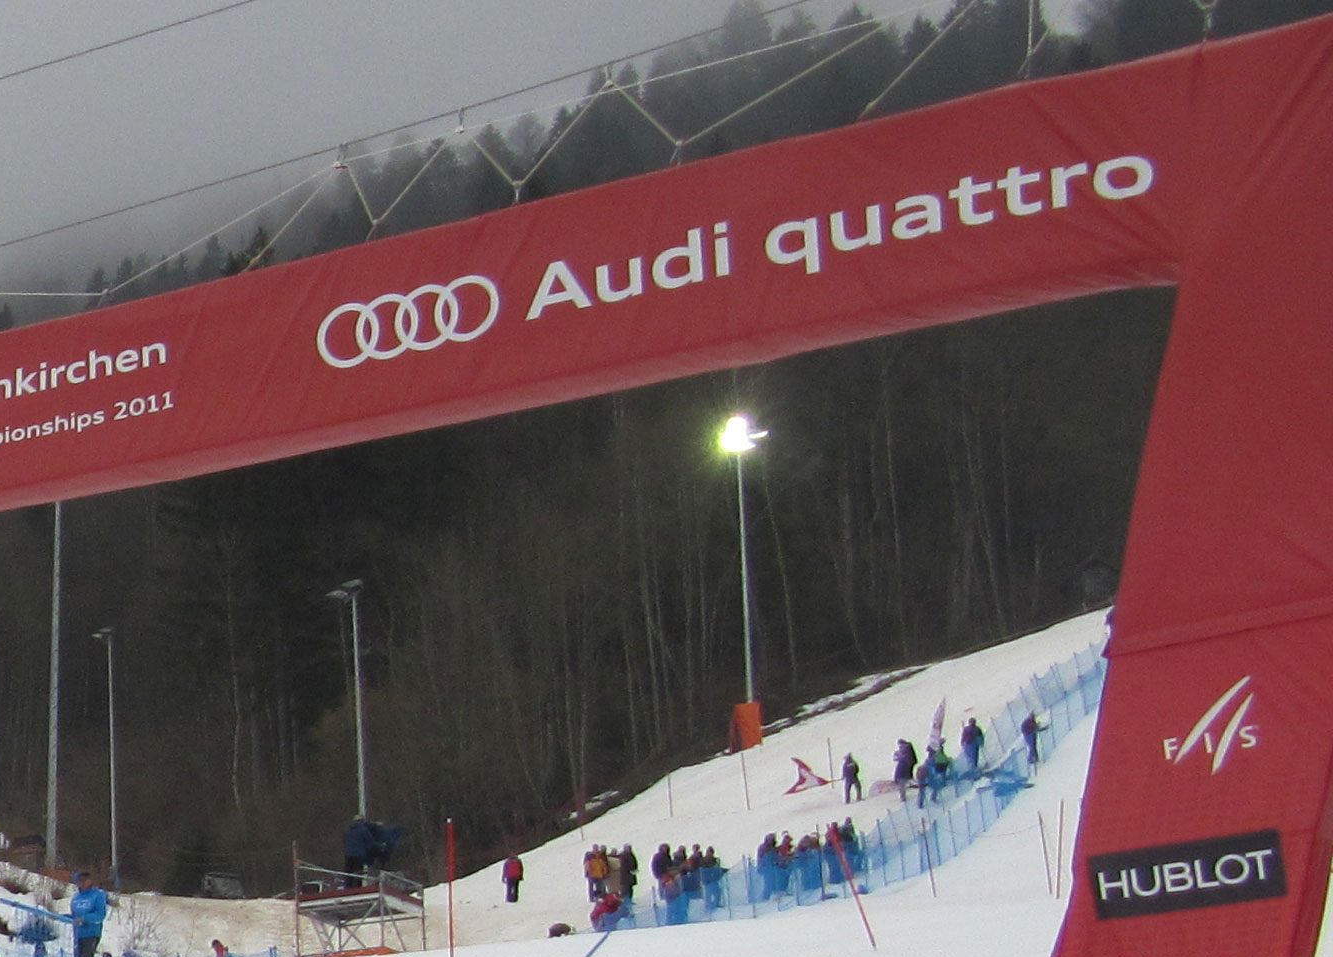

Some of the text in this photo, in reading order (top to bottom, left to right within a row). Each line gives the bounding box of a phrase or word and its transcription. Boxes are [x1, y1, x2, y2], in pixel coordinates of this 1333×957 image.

[525, 156, 1155, 321] Audi quattro
[113, 392, 175, 422] 2011
[1097, 849, 1273, 900] HUBLOT
